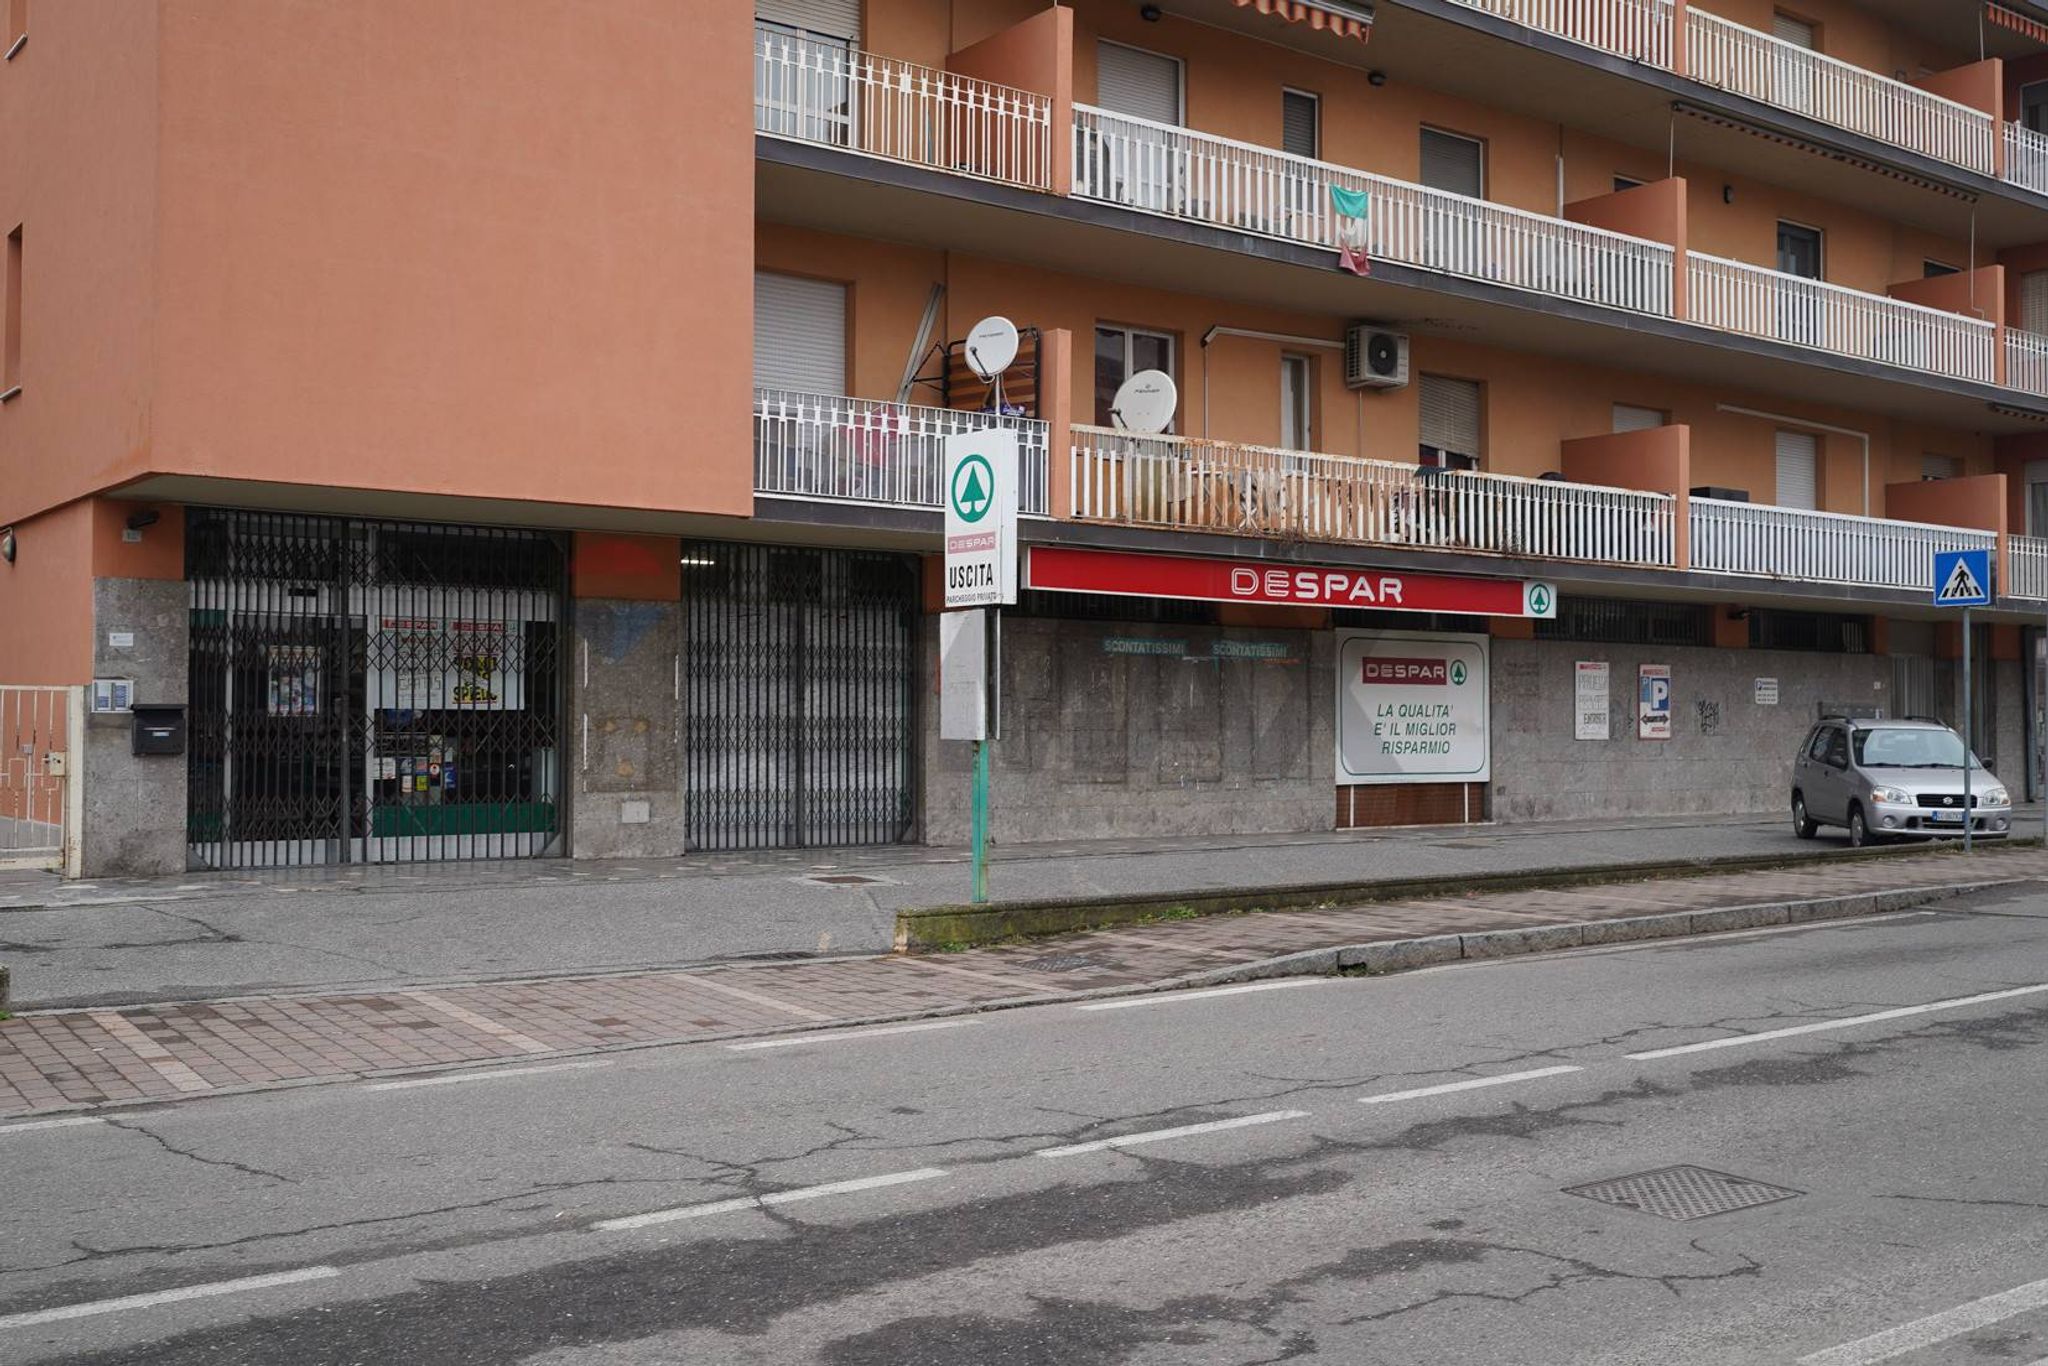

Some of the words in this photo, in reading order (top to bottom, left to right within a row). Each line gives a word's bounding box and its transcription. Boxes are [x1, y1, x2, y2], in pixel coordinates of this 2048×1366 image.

[949, 536, 994, 550] DESPAR
[949, 563, 994, 589] USCITA
[1231, 567, 1403, 604] DESPAR
[1104, 640, 1185, 655] SCONTATISSIMI
[1212, 643, 1288, 658] SCONTATISSIMI
[1365, 663, 1445, 679] DESPAR
[1652, 680, 1668, 709] P
[1377, 704, 1393, 717] LA
[1398, 704, 1454, 718] QUALITA'
[1374, 722, 1387, 736] E'
[1389, 722, 1401, 736] IL
[1405, 722, 1457, 736] MIGLIOR
[1381, 740, 1451, 754] RISPARMIO
